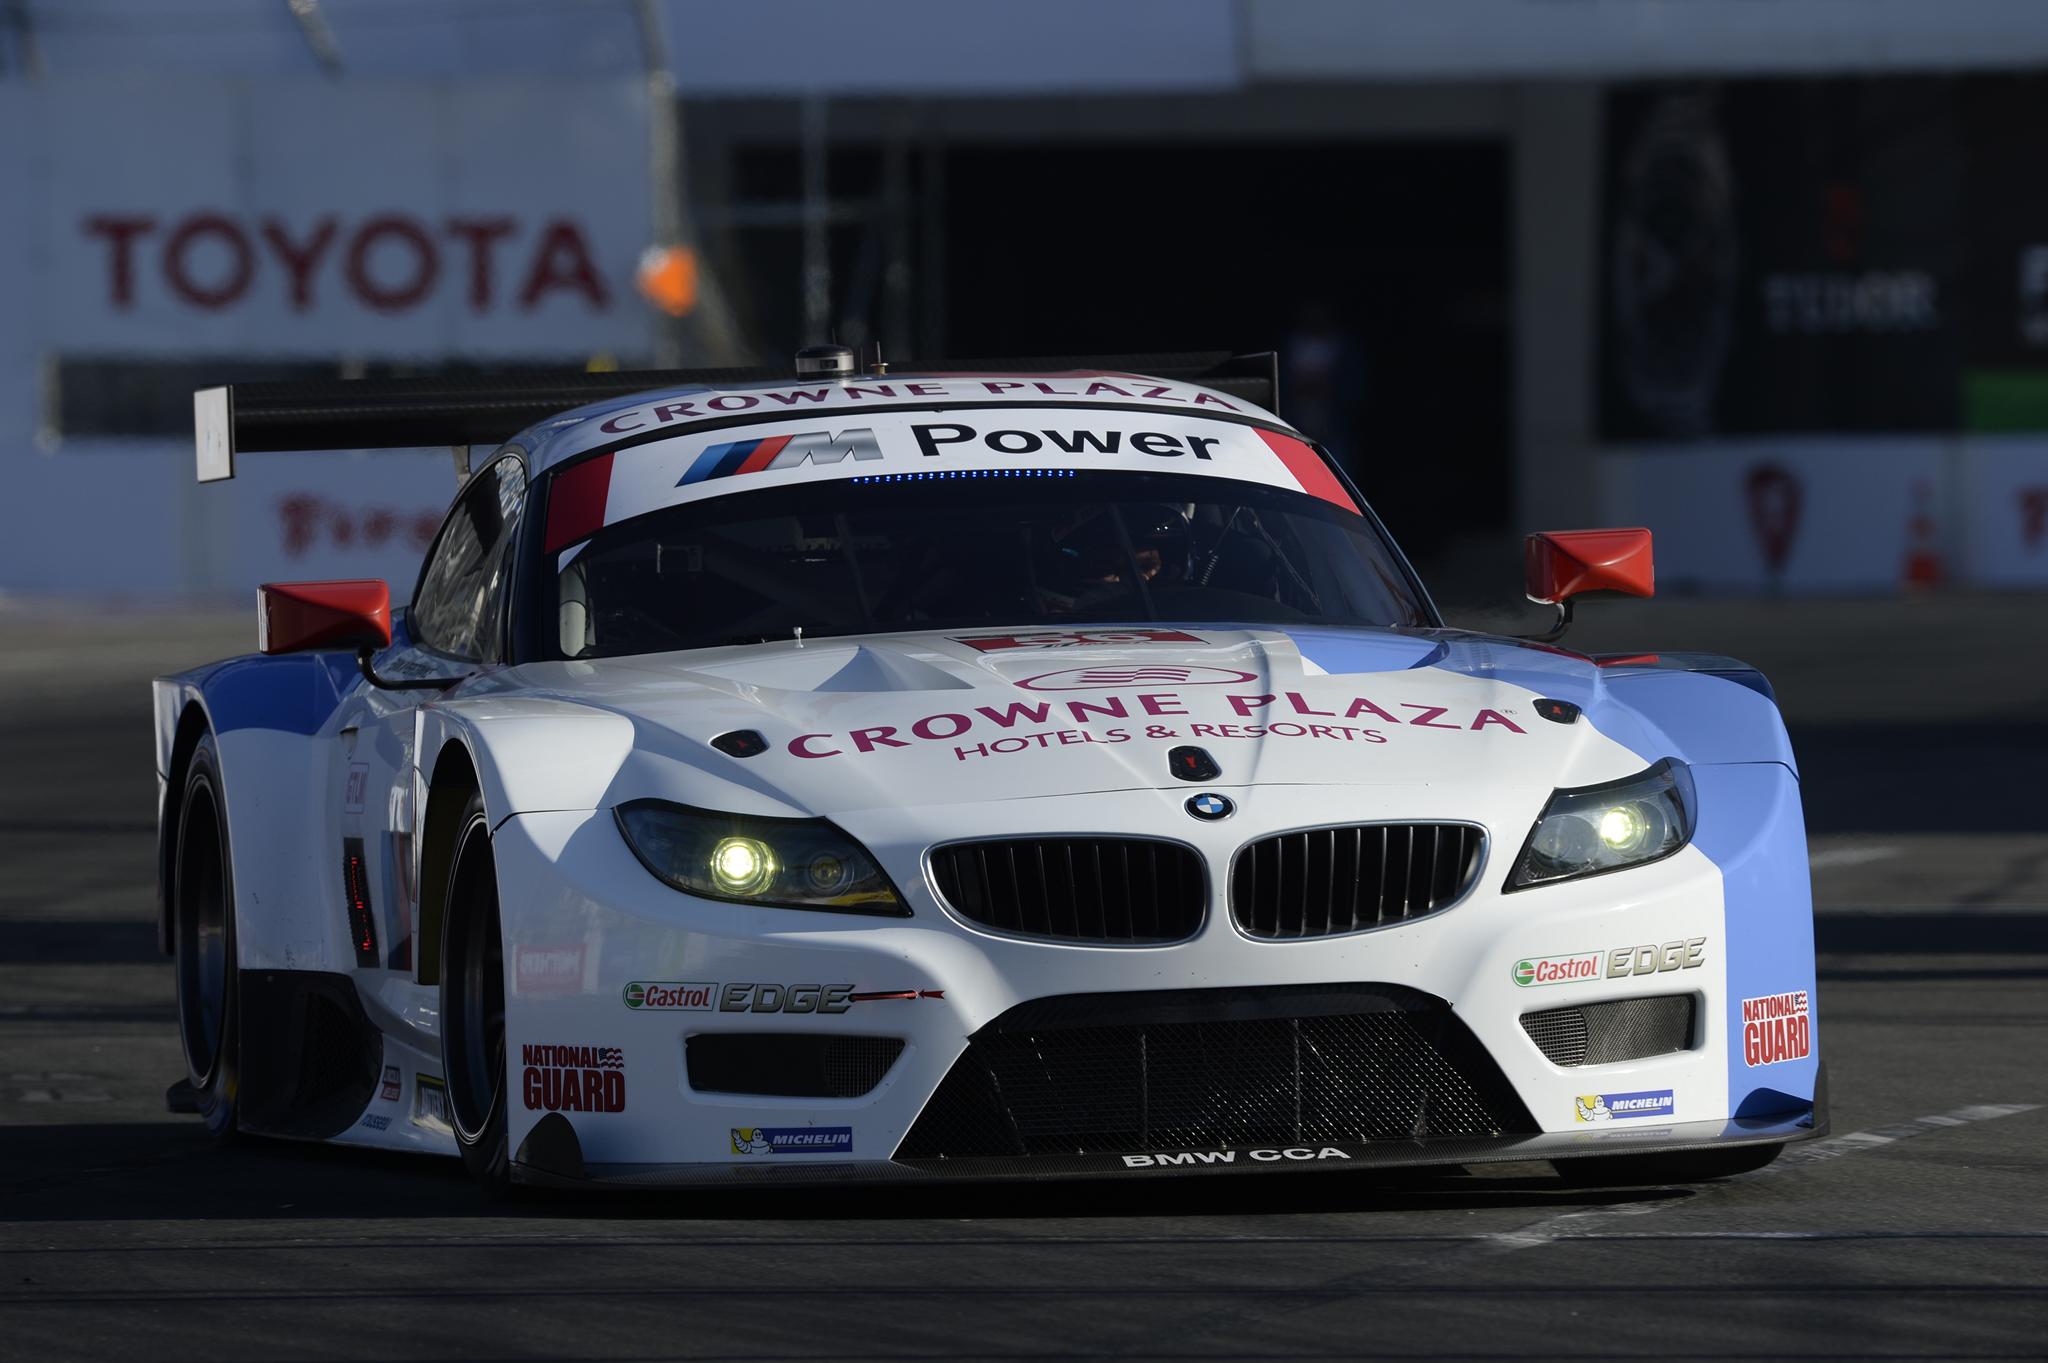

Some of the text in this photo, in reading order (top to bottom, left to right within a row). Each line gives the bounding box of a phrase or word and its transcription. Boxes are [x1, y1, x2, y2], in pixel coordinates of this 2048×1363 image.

[82, 210, 612, 314] TOYOTA
[600, 381, 1241, 434] CROWNE PLAZA
[910, 423, 1220, 461] Power
[787, 692, 1529, 759] CROWNE PLAZA
[953, 722, 1388, 761] HOTELS & RESORTS
[1535, 937, 1707, 982] Castrol EDGE
[645, 983, 856, 1014] Castrol EDGE
[1743, 993, 1797, 1022] NATIONAL
[522, 1044, 601, 1068] NATIONAL
[1744, 1015, 1810, 1067] GUARD
[523, 1066, 626, 1113] GUARD
[1611, 1095, 1673, 1111] MICHELIN
[771, 1132, 851, 1146] MICHELIN
[1121, 1147, 1352, 1168] BMW CCA
